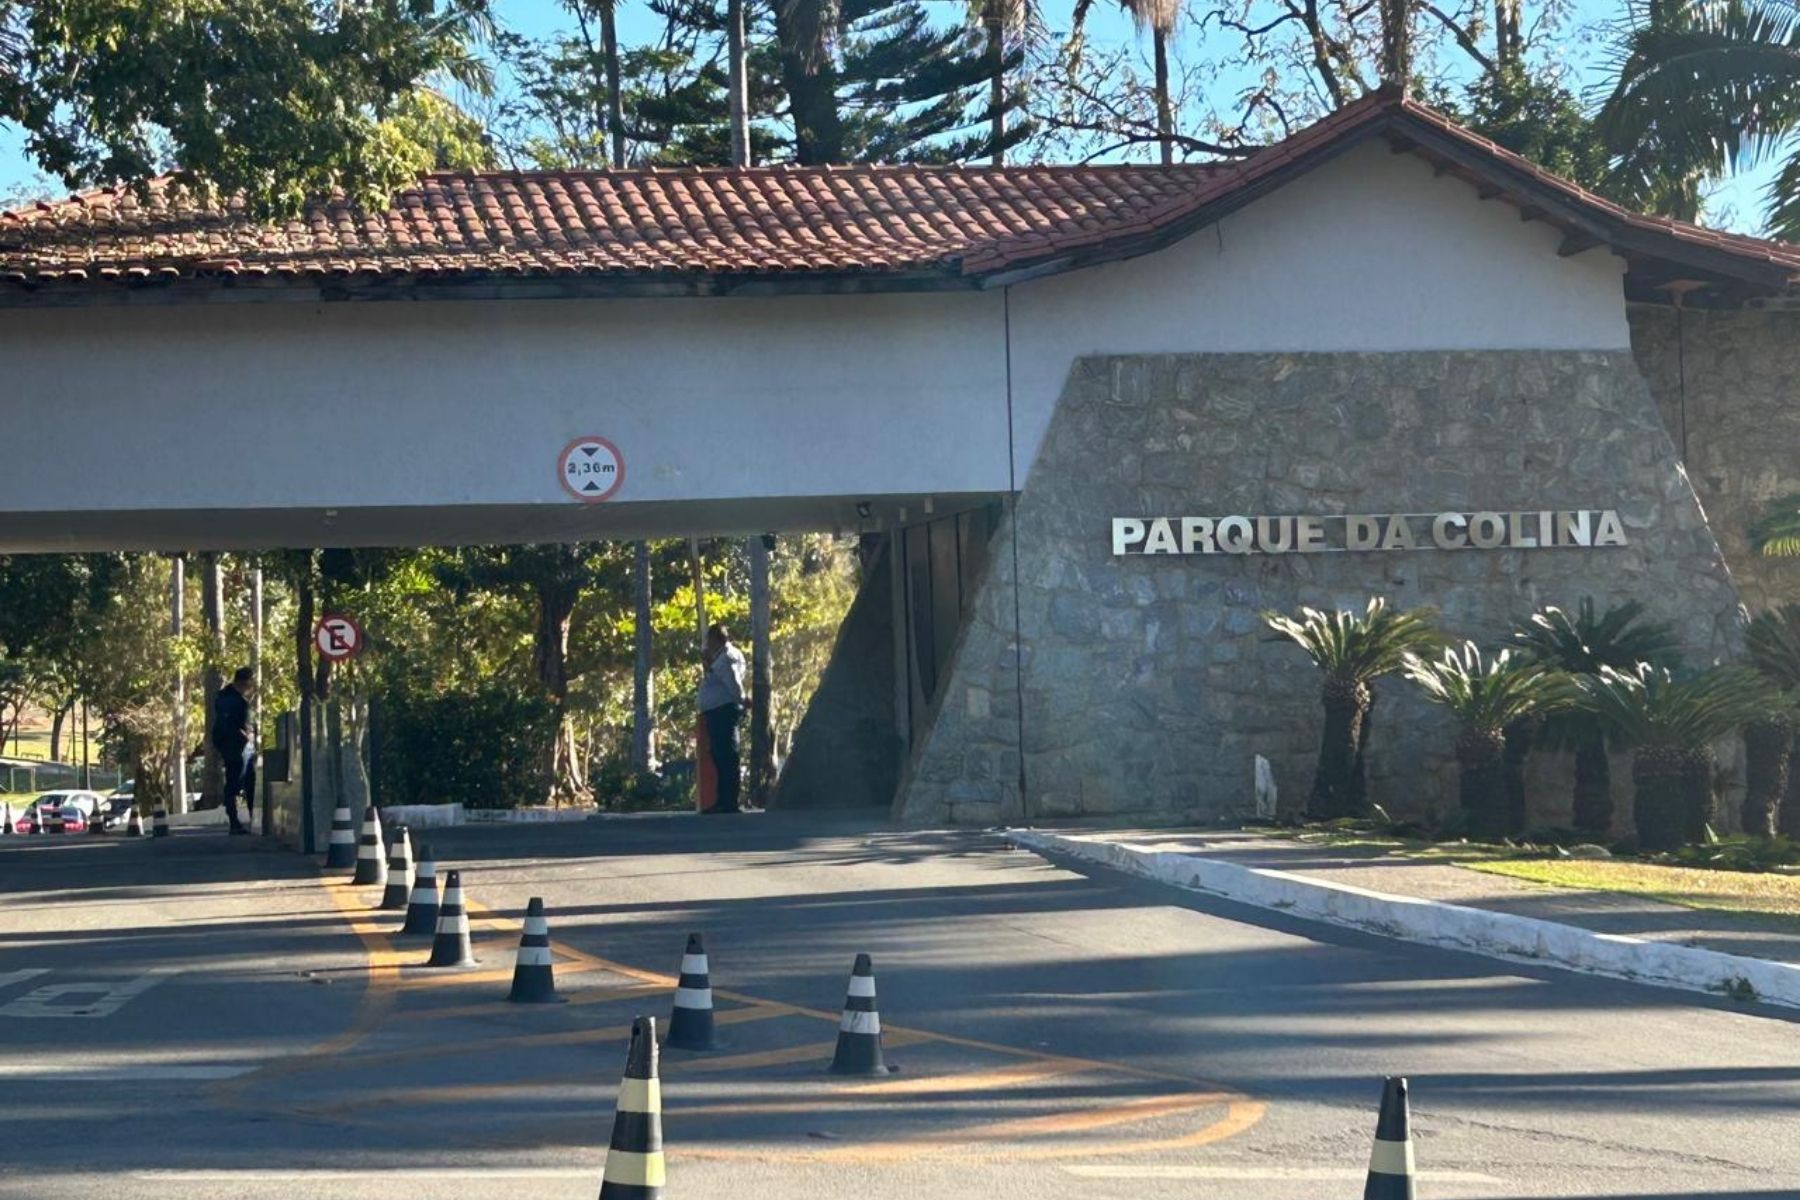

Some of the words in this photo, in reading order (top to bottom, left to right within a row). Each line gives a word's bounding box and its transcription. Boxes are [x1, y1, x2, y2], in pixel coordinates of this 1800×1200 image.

[1112, 515, 1328, 555] PARQUE
[1346, 514, 1415, 549] DA
[1432, 509, 1629, 549] COLINA
